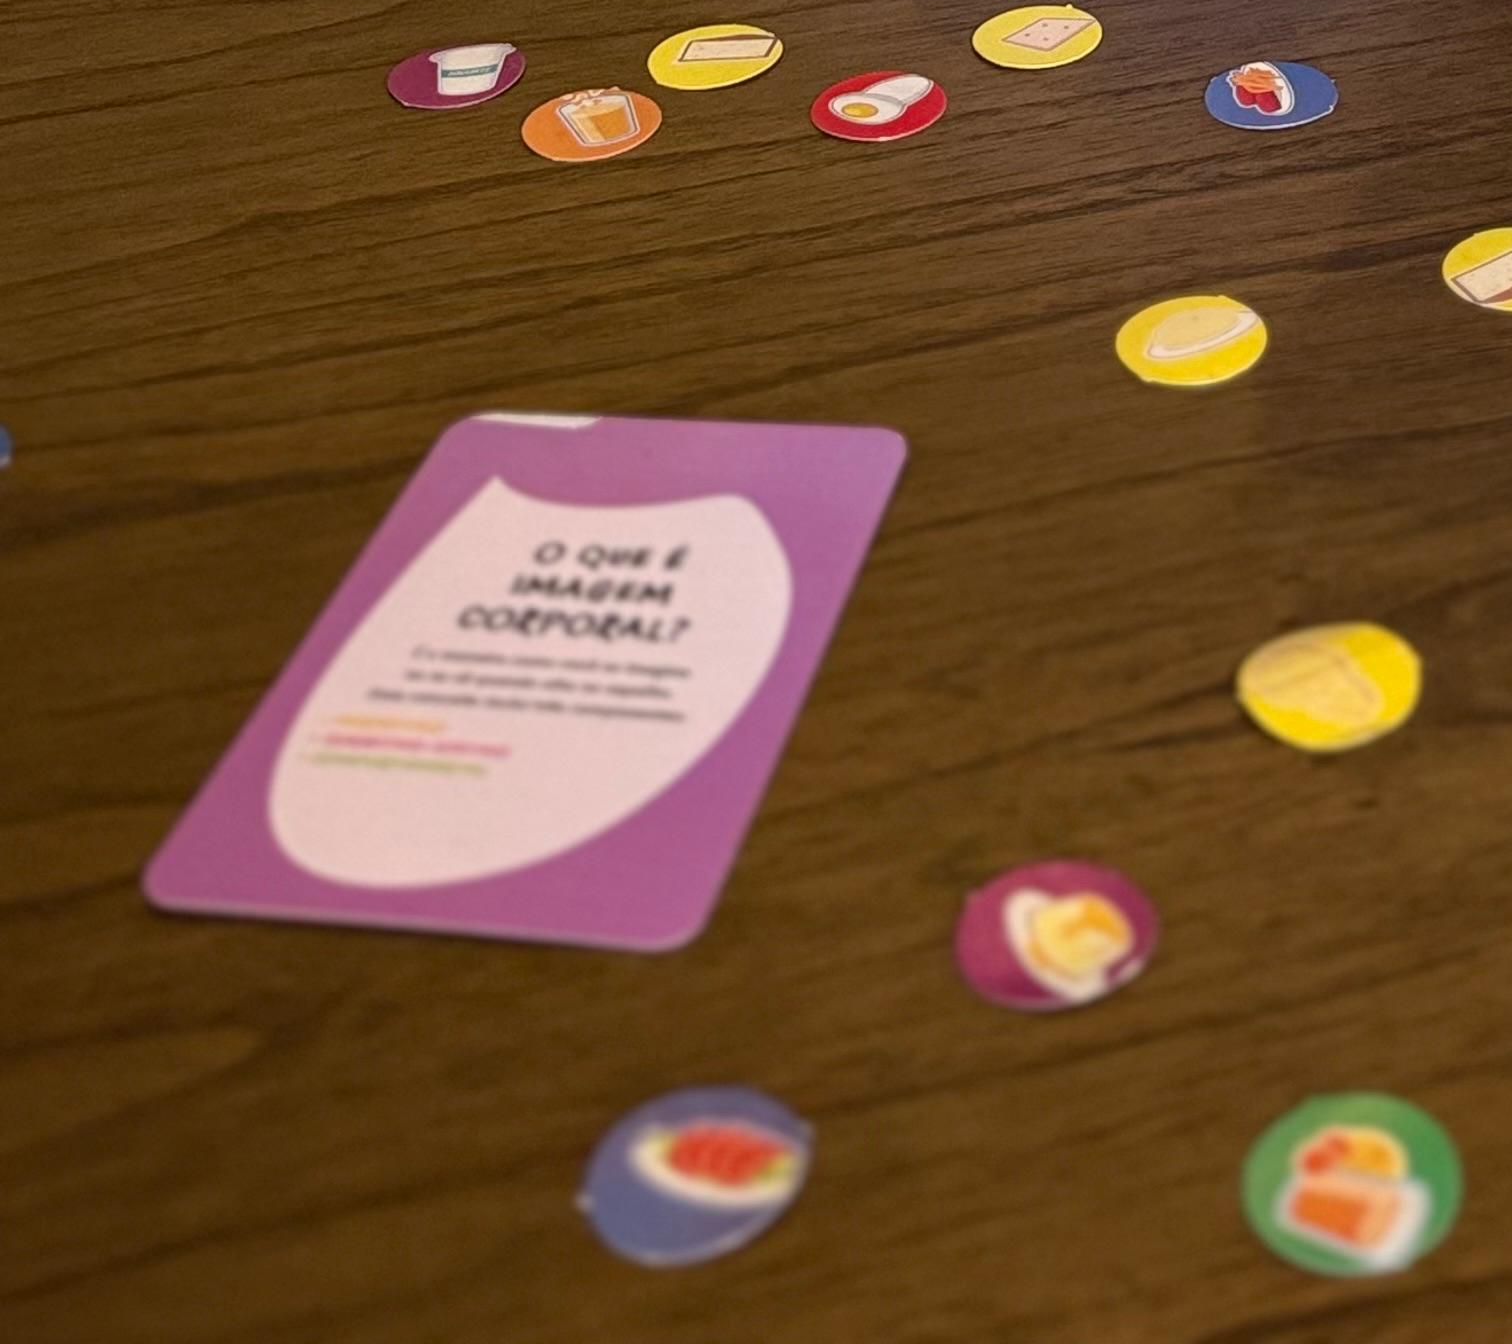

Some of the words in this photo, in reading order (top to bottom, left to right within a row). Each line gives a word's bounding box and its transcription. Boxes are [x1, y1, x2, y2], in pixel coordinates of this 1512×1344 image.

[533, 540, 567, 565] O
[576, 544, 650, 570] QUE
[509, 574, 673, 605] IMAGEM
[457, 604, 691, 643] CORPORAL?
